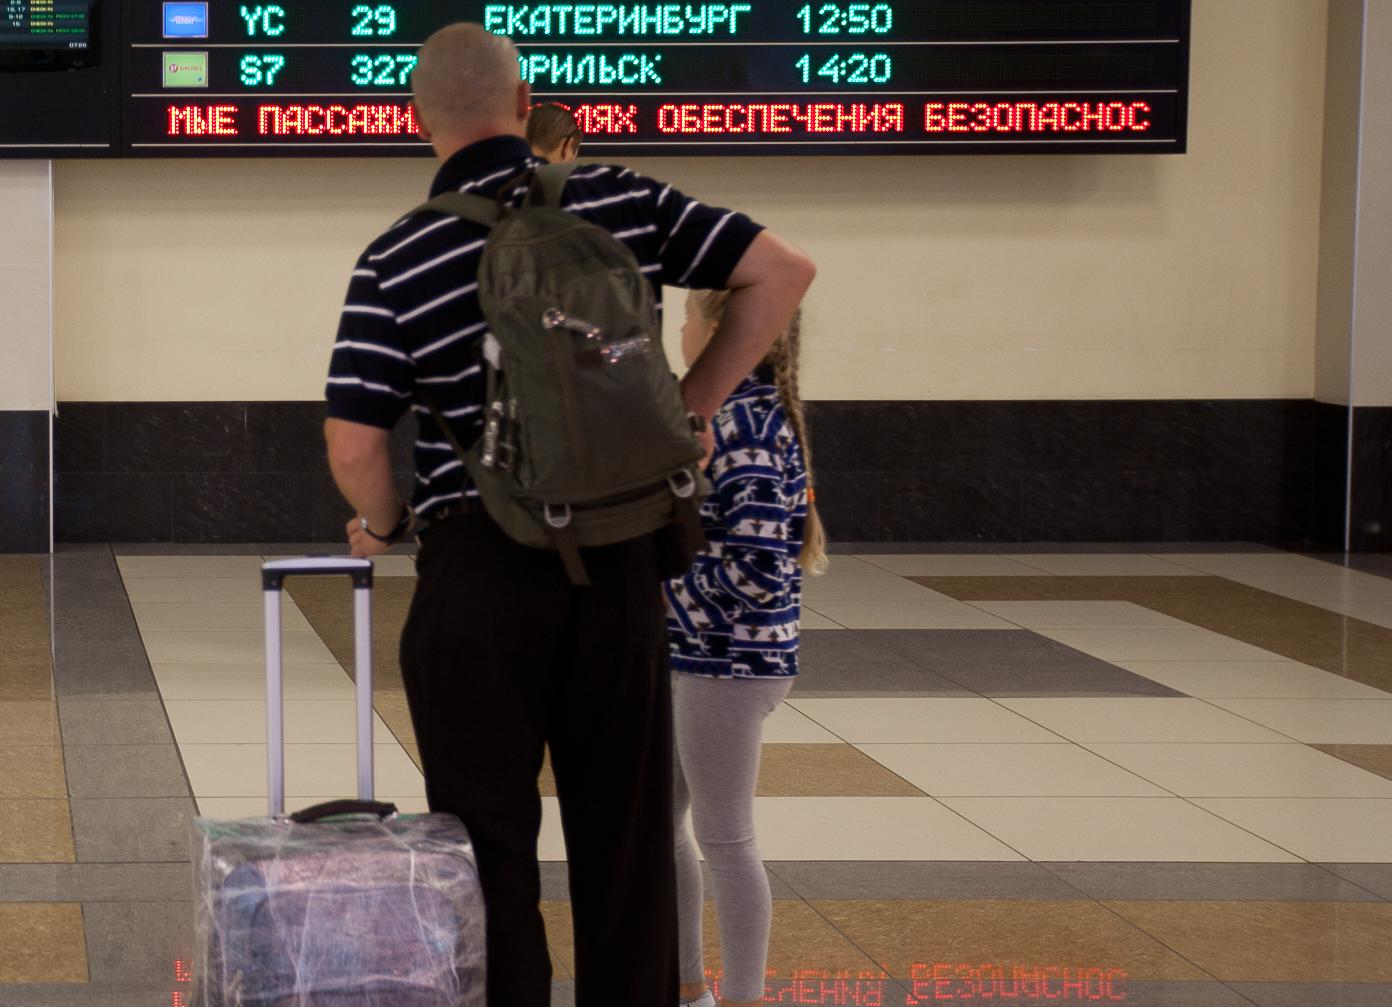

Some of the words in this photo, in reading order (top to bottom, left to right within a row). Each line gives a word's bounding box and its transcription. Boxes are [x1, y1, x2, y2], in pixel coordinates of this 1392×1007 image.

[351, 5, 396, 36] 29
[485, 4, 752, 36] ЕКАТЕРИНБУРГ
[797, 4, 893, 35] 12:50
[240, 55, 286, 86] S7
[351, 55, 418, 85] 327
[518, 54, 662, 84] РИЛЬСК
[796, 53, 892, 84] 14:20
[167, 104, 239, 136] МЫЕ
[258, 104, 421, 136] ПАССАЖИ
[657, 103, 905, 134] ОБЕСПЕЧЕНИЯ
[924, 102, 1151, 133] БЕЗОПАСНОС
